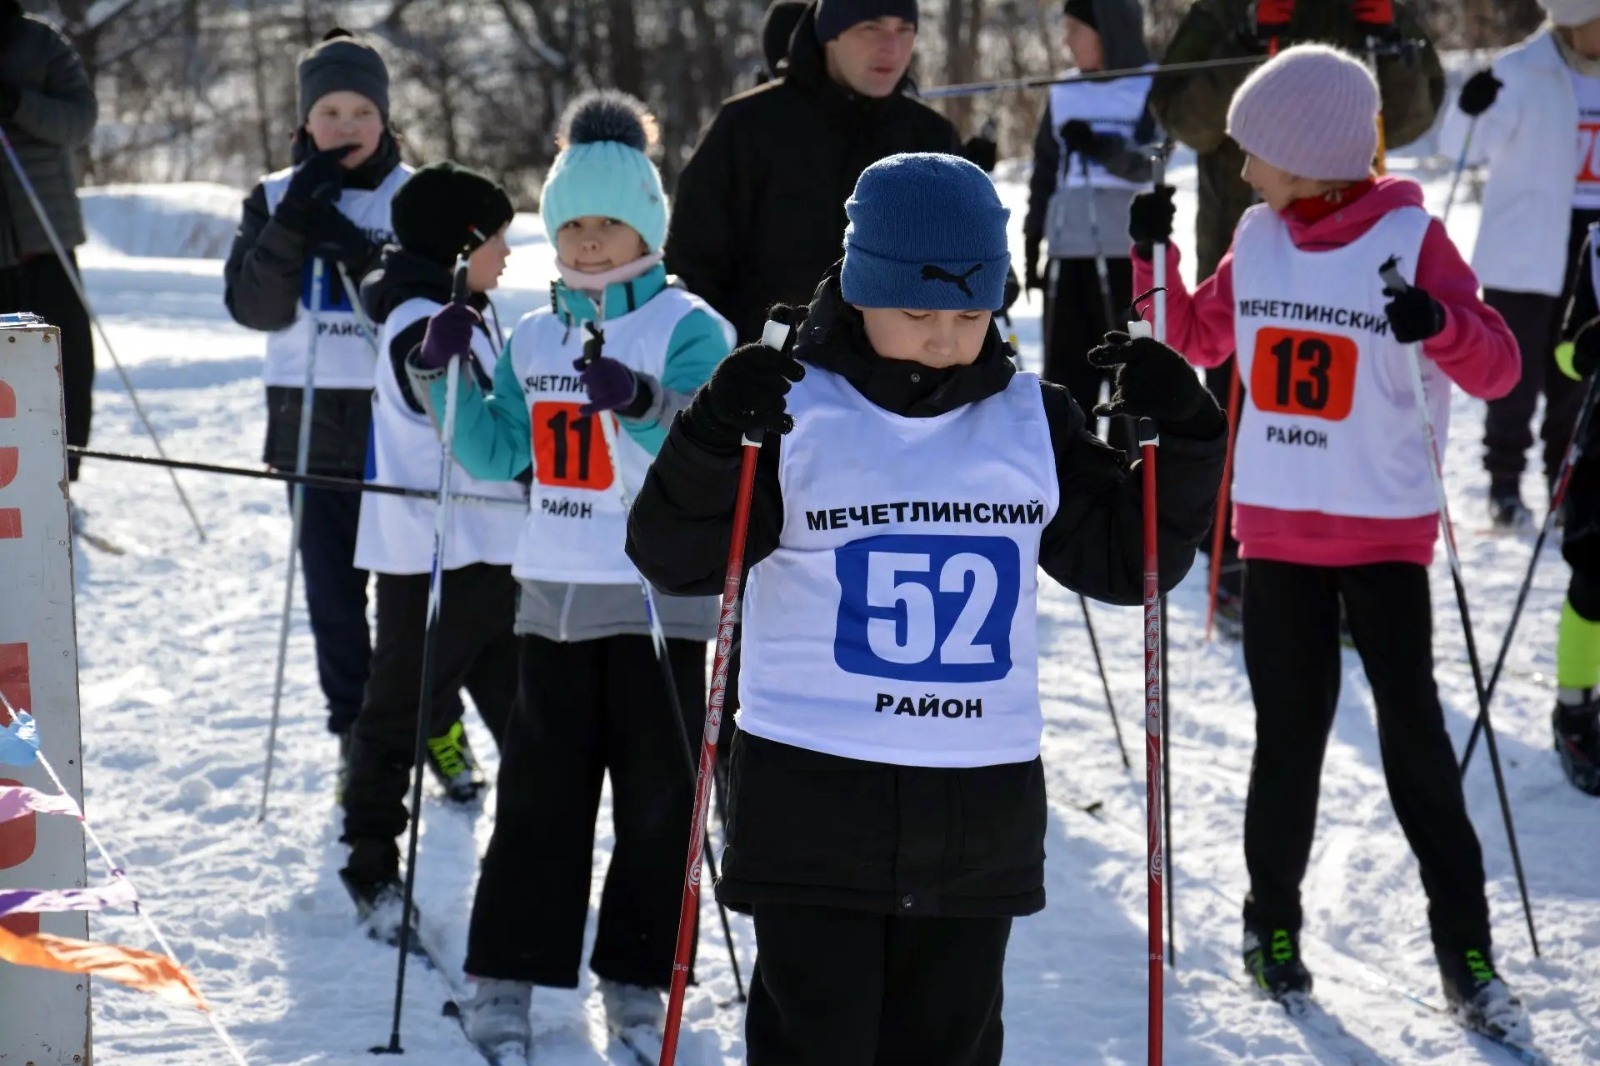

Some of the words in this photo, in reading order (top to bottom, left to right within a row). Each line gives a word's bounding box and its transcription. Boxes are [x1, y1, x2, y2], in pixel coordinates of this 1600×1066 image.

[1271, 336, 1332, 411] 13
[547, 409, 593, 482] 11
[1266, 424, 1329, 450] РАЙОН
[541, 497, 593, 520] РАЙОН
[805, 499, 1045, 531] МЕЧЕТЛИНСКИЙ
[866, 551, 999, 665] 52
[874, 692, 983, 719] РАЙОН
